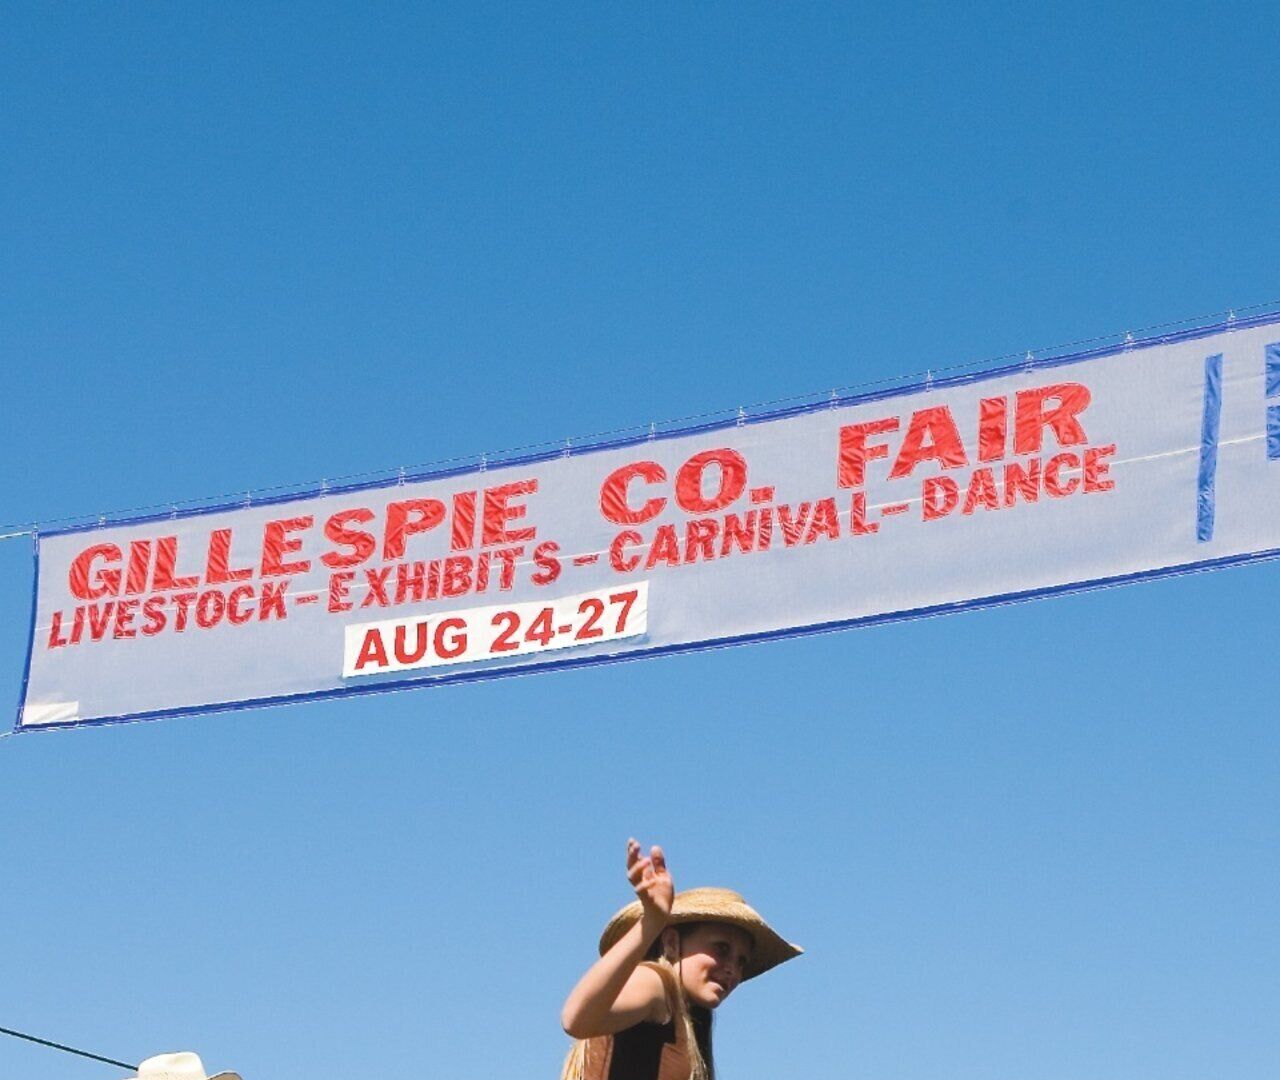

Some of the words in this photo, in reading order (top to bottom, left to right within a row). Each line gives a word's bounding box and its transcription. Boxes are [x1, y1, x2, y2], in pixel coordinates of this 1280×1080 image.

[68, 478, 539, 601] GILLESPIE
[598, 447, 776, 528] CO.
[836, 381, 1092, 490] FAIR
[354, 616, 468, 670] AUG
[489, 589, 639, 653] 24-27
